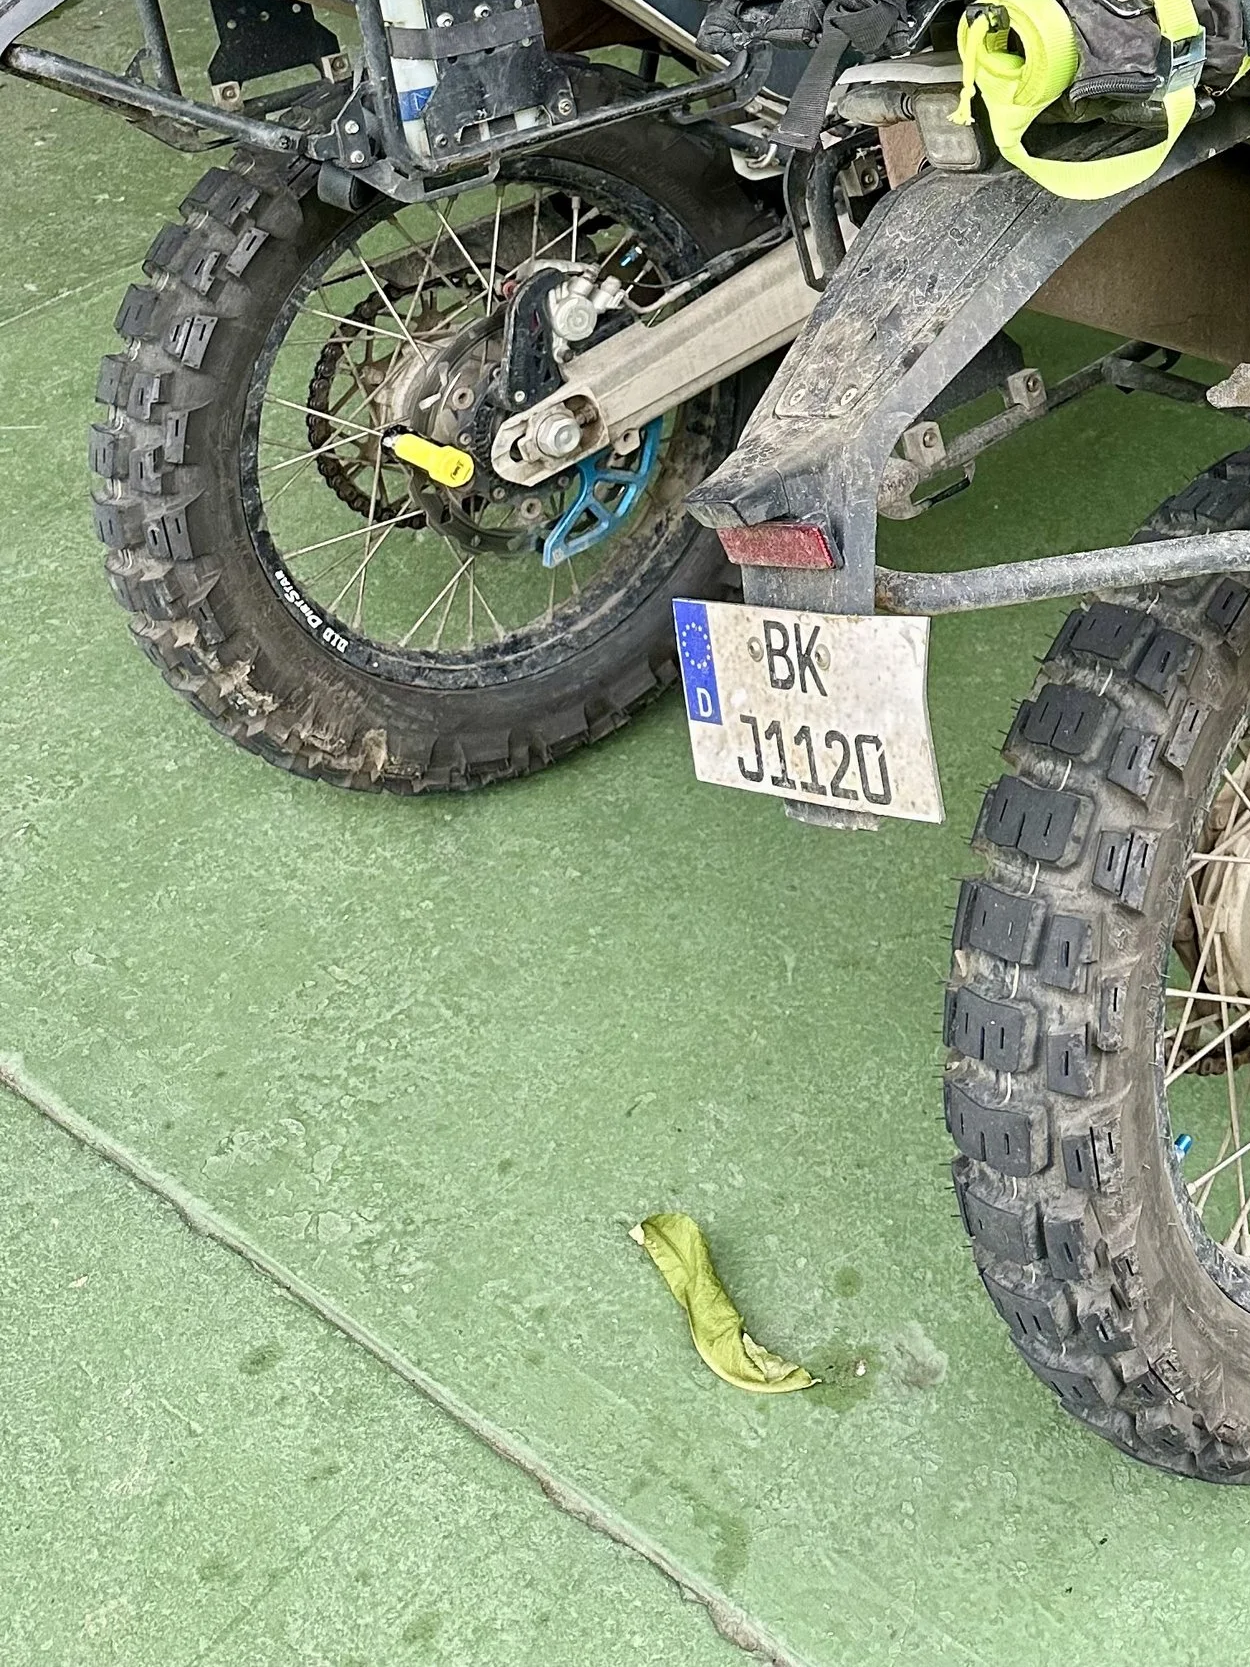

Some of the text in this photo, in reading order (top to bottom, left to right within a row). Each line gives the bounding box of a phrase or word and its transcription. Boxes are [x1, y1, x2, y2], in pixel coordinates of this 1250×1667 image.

[322, 627, 349, 653] DID
[762, 619, 828, 697] BK
[696, 687, 713, 718] D
[737, 714, 892, 805] J1120
